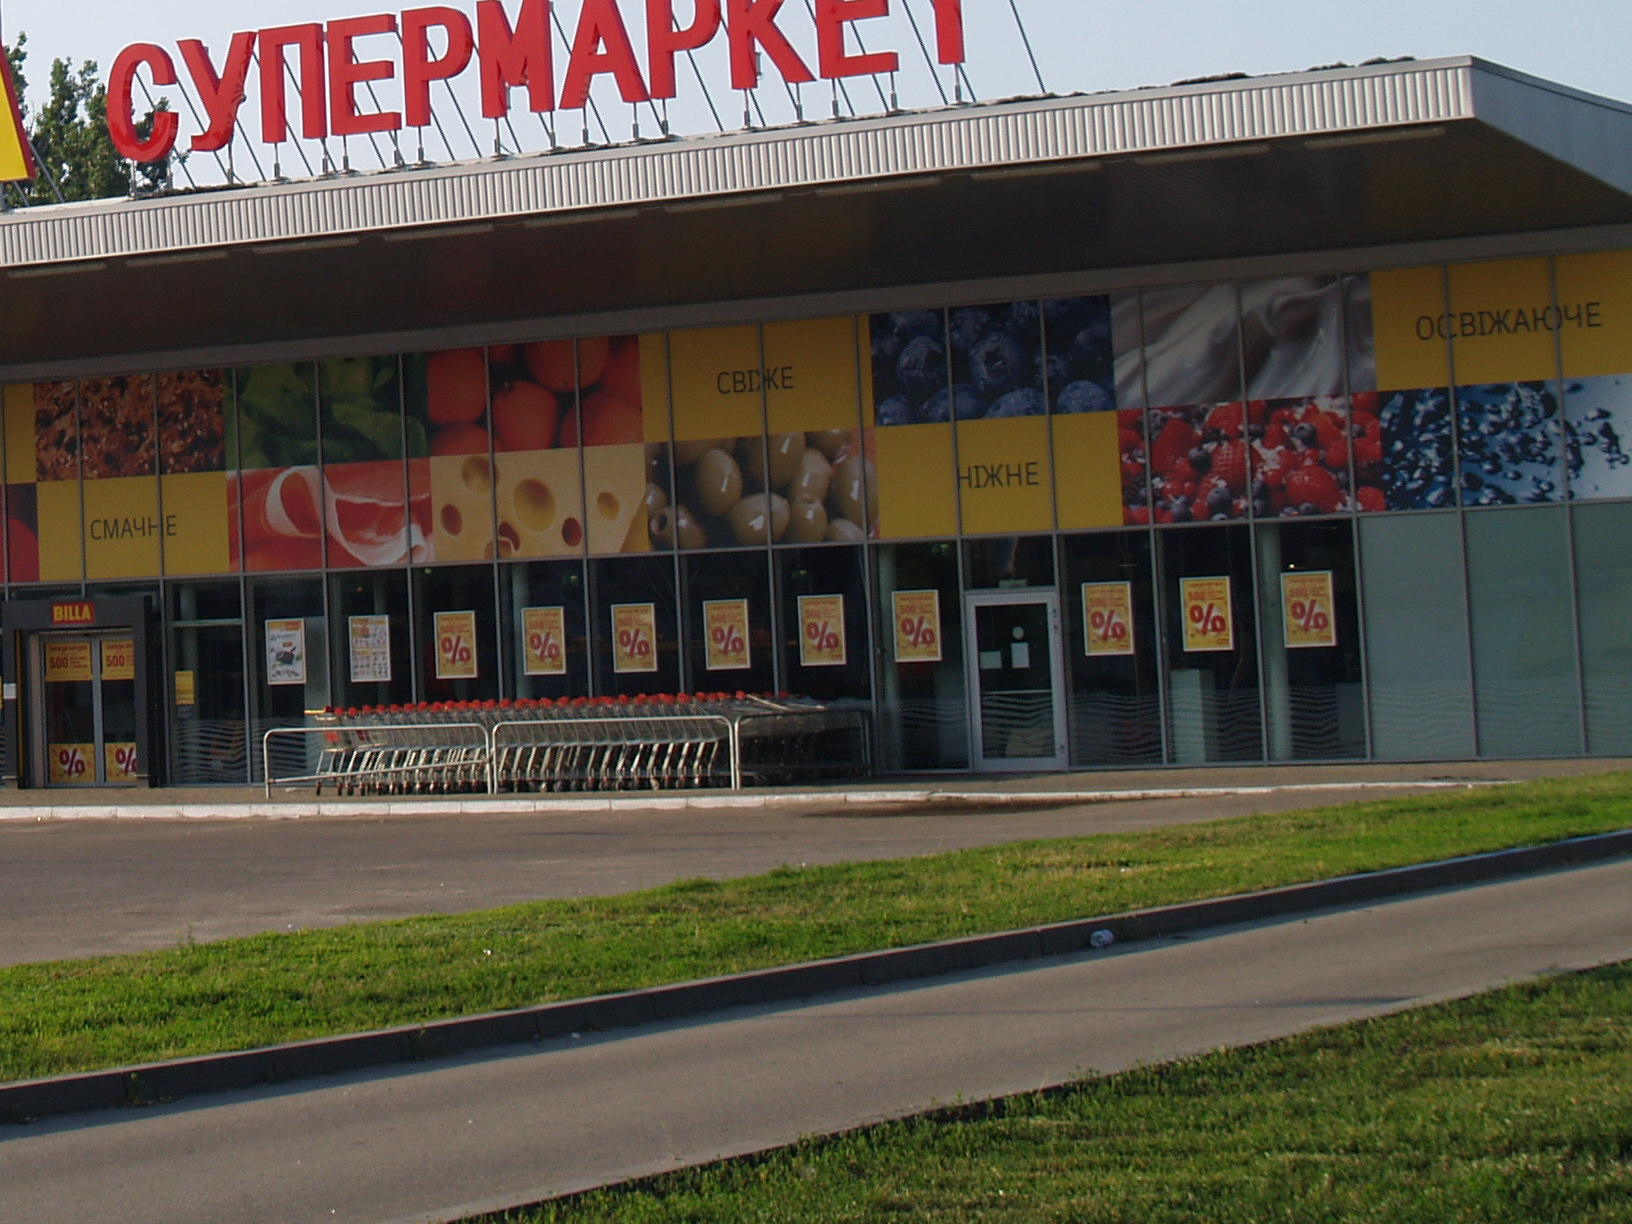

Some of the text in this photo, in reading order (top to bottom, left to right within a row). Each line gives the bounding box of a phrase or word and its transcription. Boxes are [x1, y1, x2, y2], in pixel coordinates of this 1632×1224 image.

[1415, 301, 1602, 341] ОСВІЖАЮЧЕ
[716, 365, 795, 395] СВІЖЕ
[955, 461, 1039, 490] НІЖНЕ
[90, 515, 177, 541] СМАЧНЕ
[53, 603, 92, 622] BILLA
[49, 657, 68, 669] 500
[106, 655, 125, 667] 500
